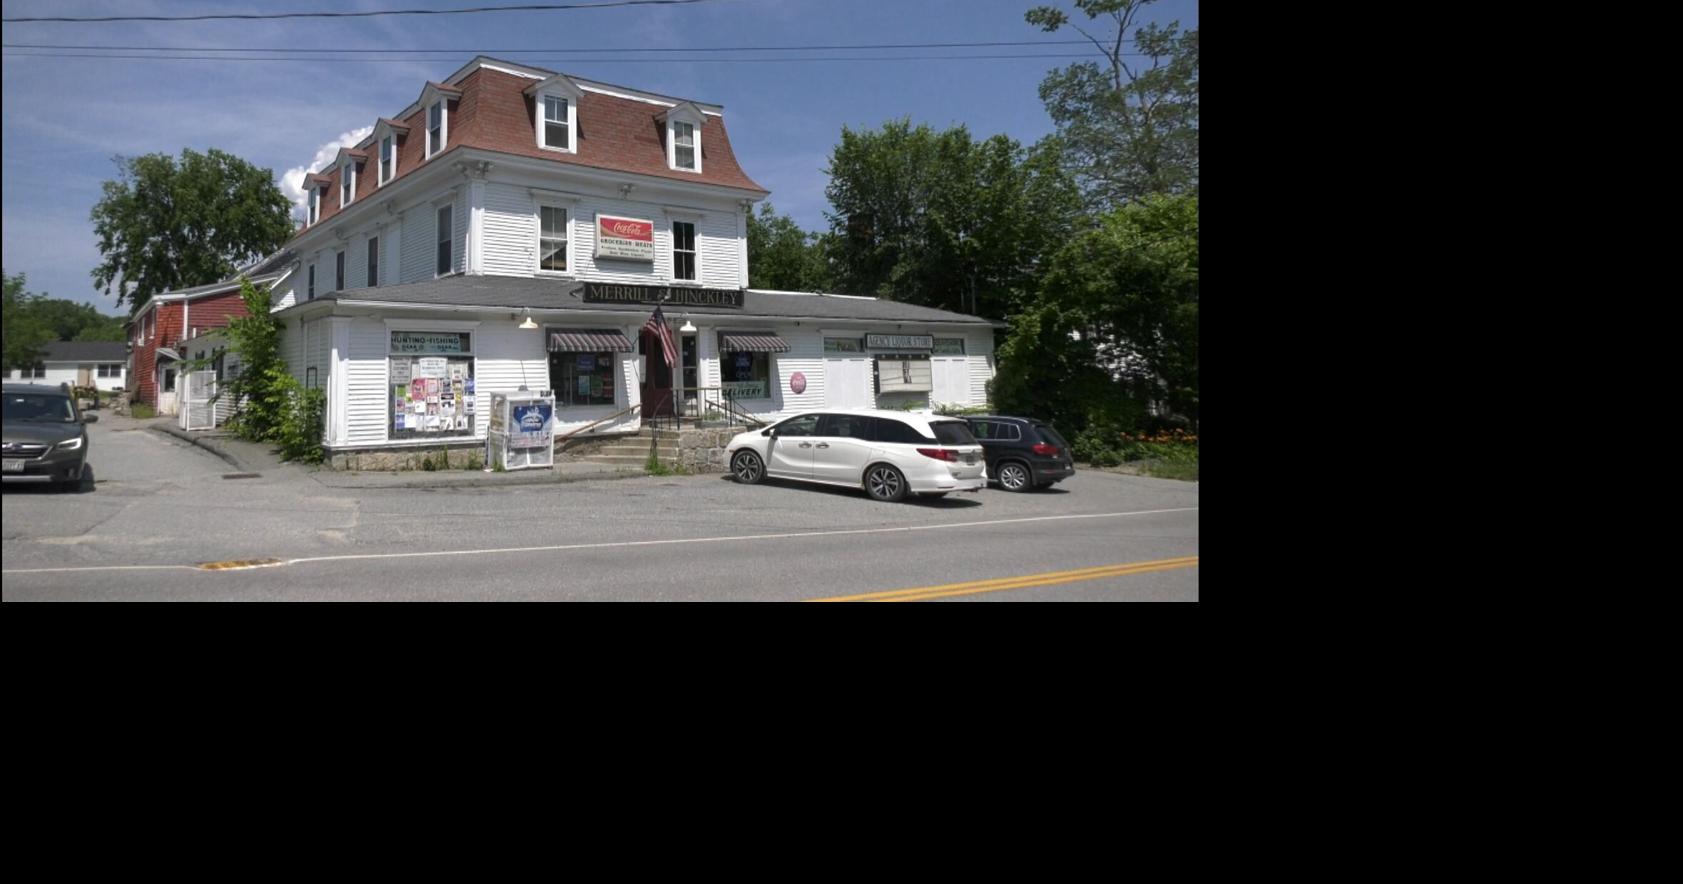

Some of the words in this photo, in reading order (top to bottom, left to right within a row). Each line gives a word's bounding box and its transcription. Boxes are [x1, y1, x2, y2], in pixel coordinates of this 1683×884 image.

[591, 284, 650, 300] MERRILL
[676, 289, 738, 305] HINCKLEY
[868, 334, 890, 346] AGENCY
[892, 335, 912, 347] LIQUOR
[913, 336, 931, 347] STORE
